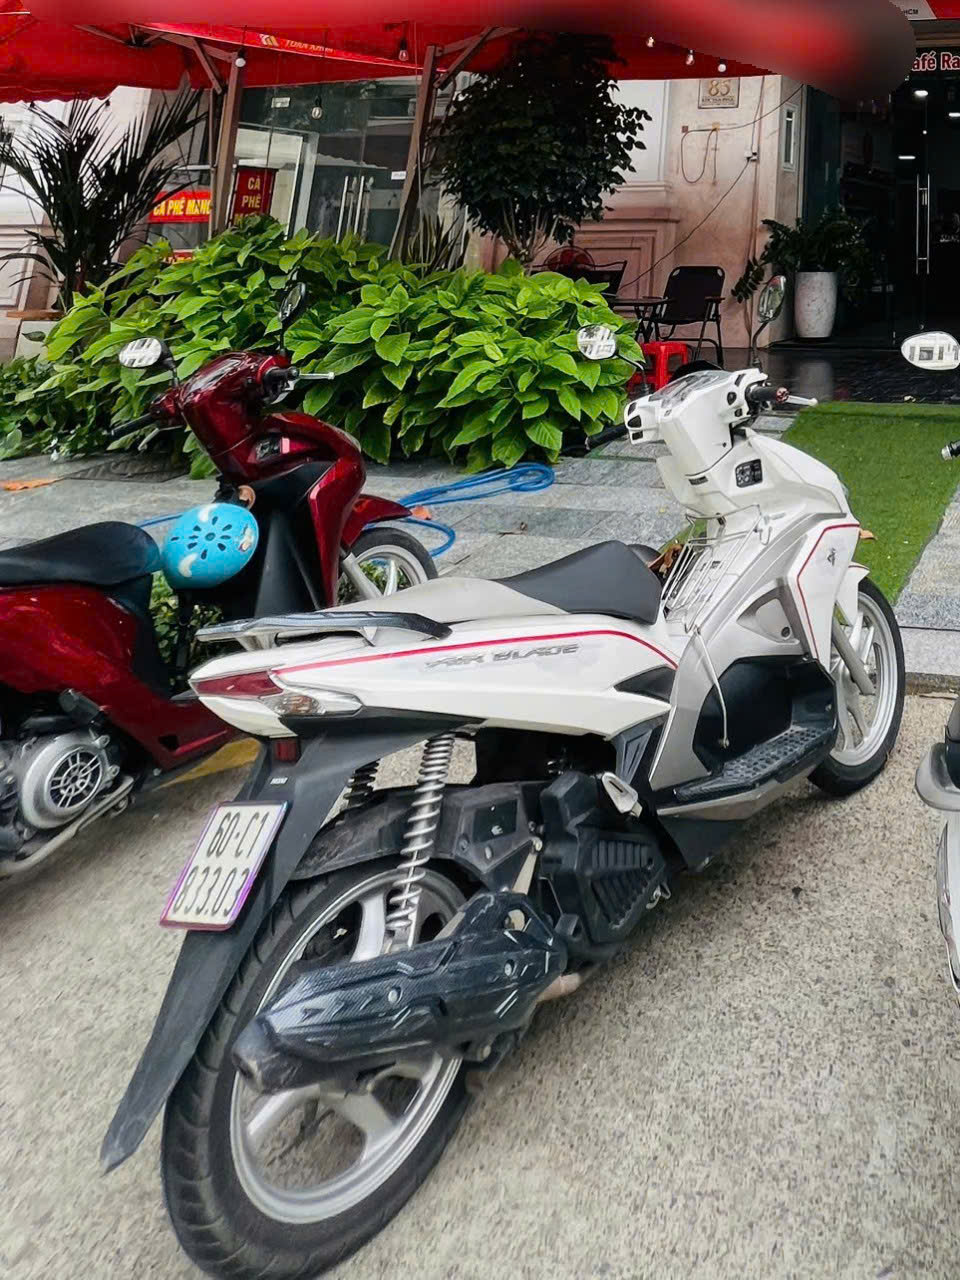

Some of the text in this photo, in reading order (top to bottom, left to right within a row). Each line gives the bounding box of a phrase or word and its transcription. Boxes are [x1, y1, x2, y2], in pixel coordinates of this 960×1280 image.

[912, 50, 937, 71] afé
[708, 80, 730, 96] 85
[206, 811, 270, 858] 60-C1
[172, 865, 250, 917] 833.03
